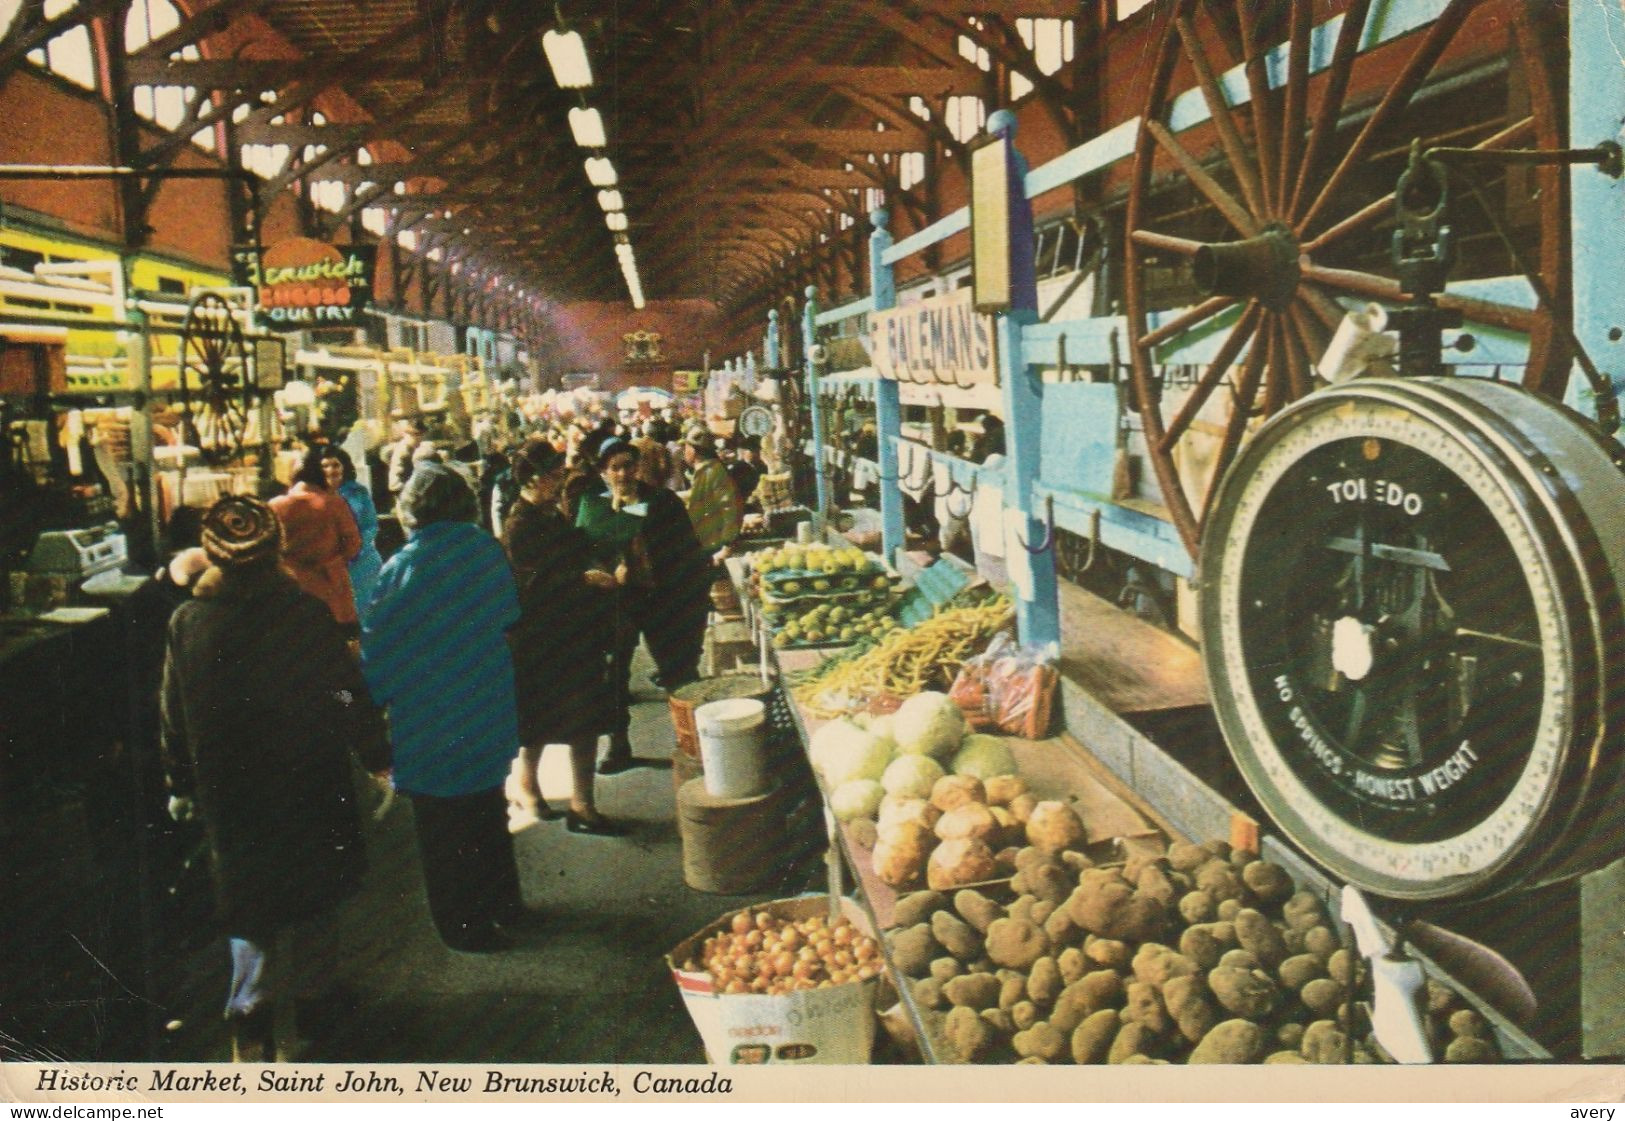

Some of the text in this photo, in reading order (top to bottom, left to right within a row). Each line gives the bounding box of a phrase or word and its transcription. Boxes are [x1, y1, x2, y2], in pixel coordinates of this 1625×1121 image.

[268, 305, 353, 321] OULTRY
[1274, 675, 1293, 702] NO
[1289, 706, 1343, 775] SPRINGS
[1355, 769, 1415, 800] HONEST
[1418, 739, 1479, 796] WEIGHT
